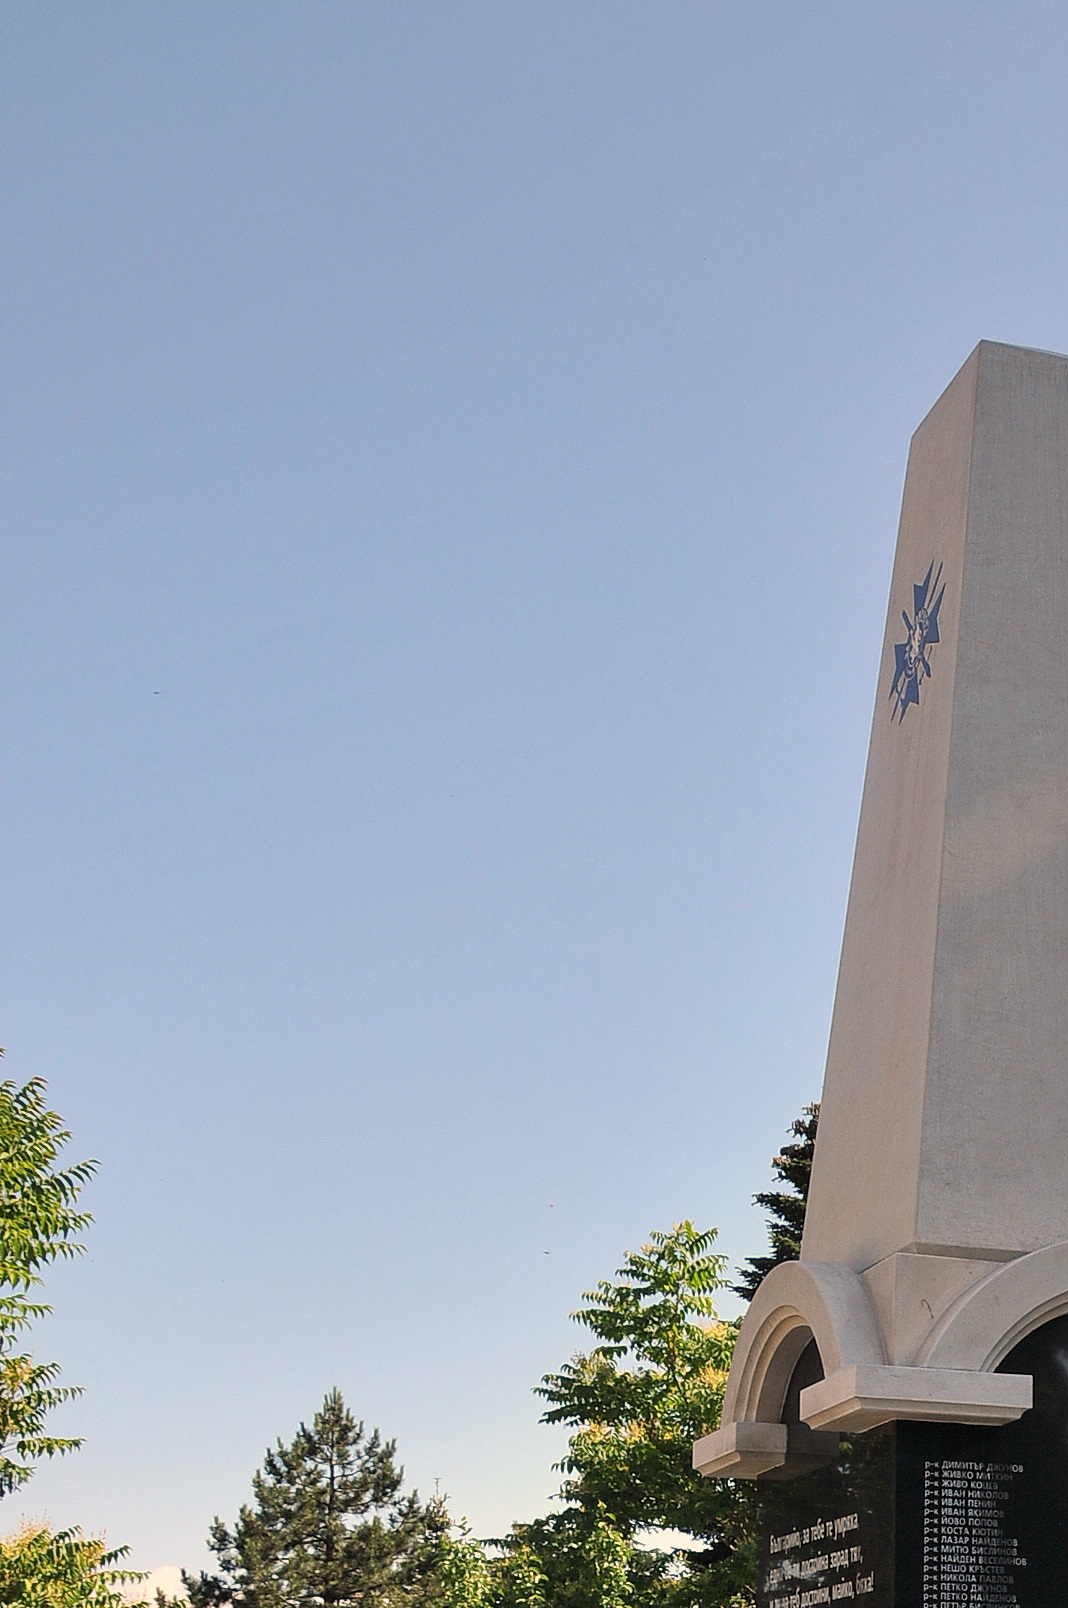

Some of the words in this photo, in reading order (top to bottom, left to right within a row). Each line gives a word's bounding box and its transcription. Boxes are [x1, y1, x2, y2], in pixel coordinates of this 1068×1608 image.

[924, 1498, 938, 1506] р-к
[924, 1517, 938, 1525] р-к
[802, 1528, 810, 1544] за
[811, 1518, 824, 1541] тебе
[826, 1521, 833, 1537] те
[830, 1549, 849, 1572] зарад
